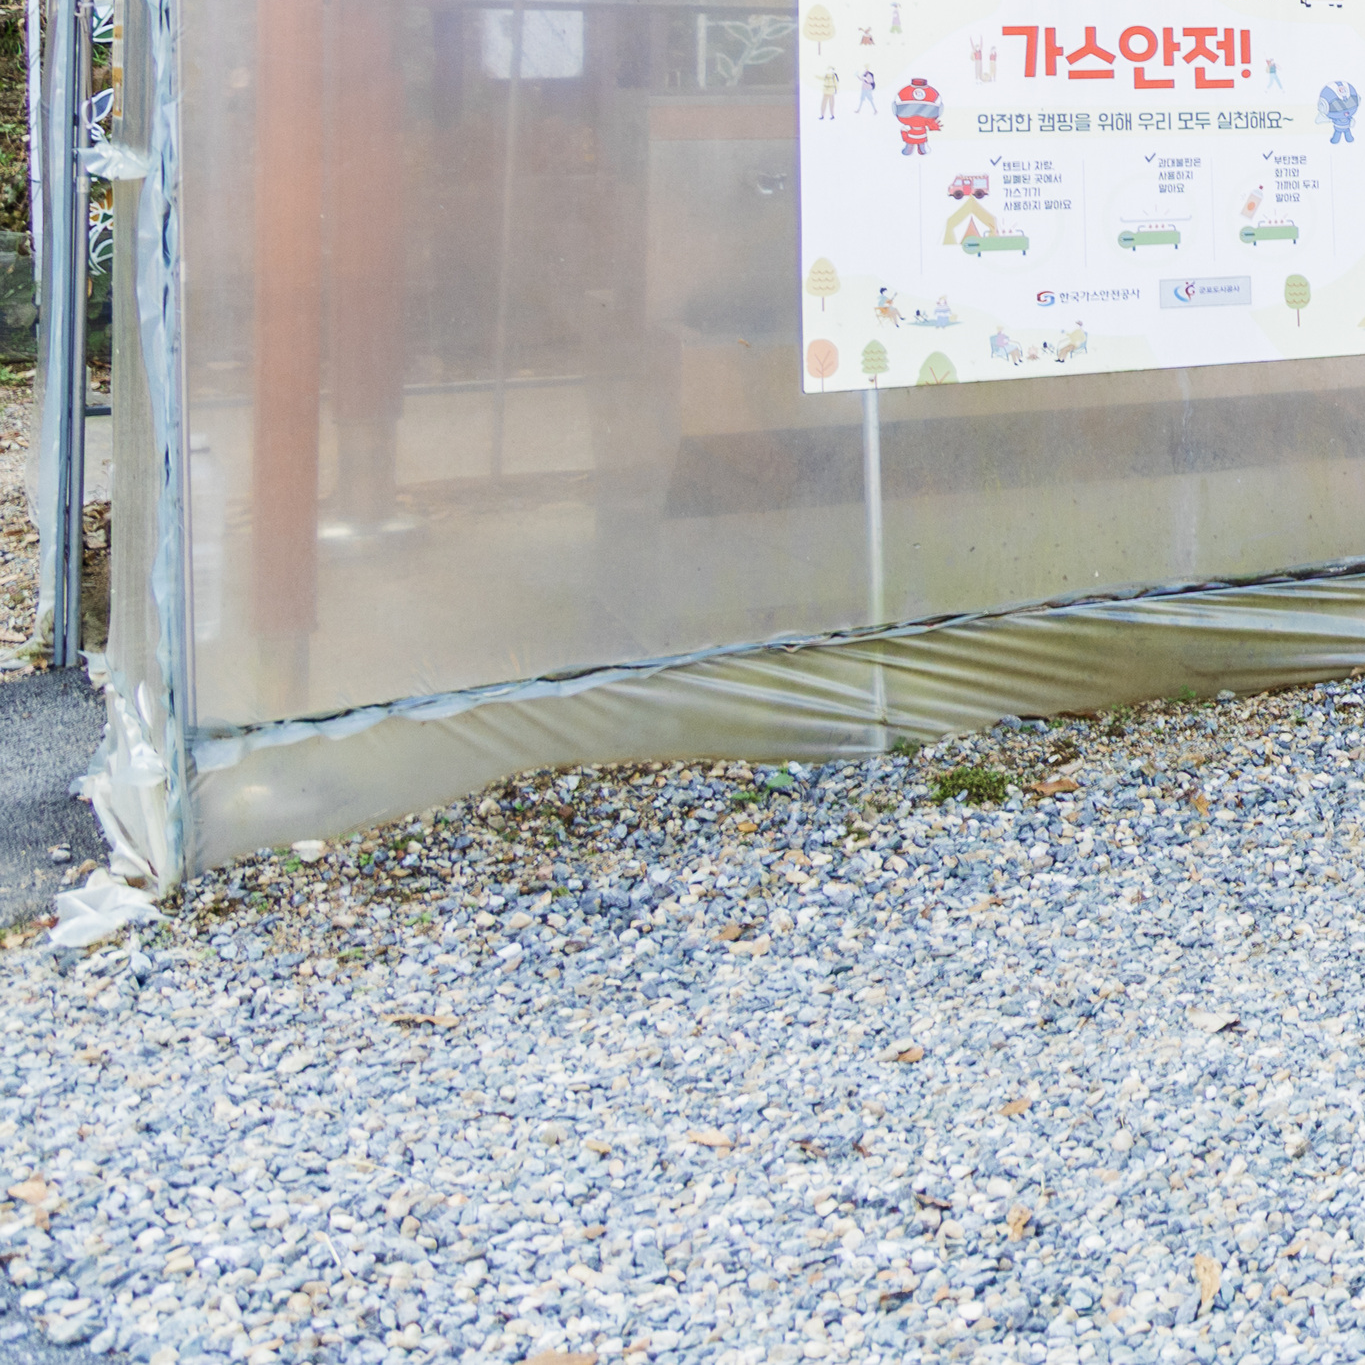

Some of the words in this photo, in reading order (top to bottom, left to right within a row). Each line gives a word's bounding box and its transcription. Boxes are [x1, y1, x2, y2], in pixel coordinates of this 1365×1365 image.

[1002, 25, 1251, 89] 가스안전!
[977, 112, 1033, 133] 안전한
[1037, 112, 1092, 132] 캠핑을
[1098, 112, 1132, 131] 위해
[1138, 111, 1172, 131] 우리
[1178, 112, 1210, 130] 모두
[1217, 111, 1294, 130] 실천해요~
[1002, 161, 1031, 171] 텐트나
[1002, 174, 1031, 184] 밀폐된
[1034, 173, 1062, 184] 곳에서
[1158, 171, 1193, 181] 사용하지
[1274, 168, 1300, 178] 화기와
[1158, 183, 1185, 193] 말아요
[1275, 180, 1301, 190] 가까이
[1303, 179, 1320, 190] 두지
[1003, 187, 1041, 198] 가스기기
[1275, 193, 1300, 203] 말아요
[1003, 201, 1041, 211] 사용하지
[1044, 199, 1072, 210] 말아요
[1059, 288, 1140, 304] 한국가스안전공사
